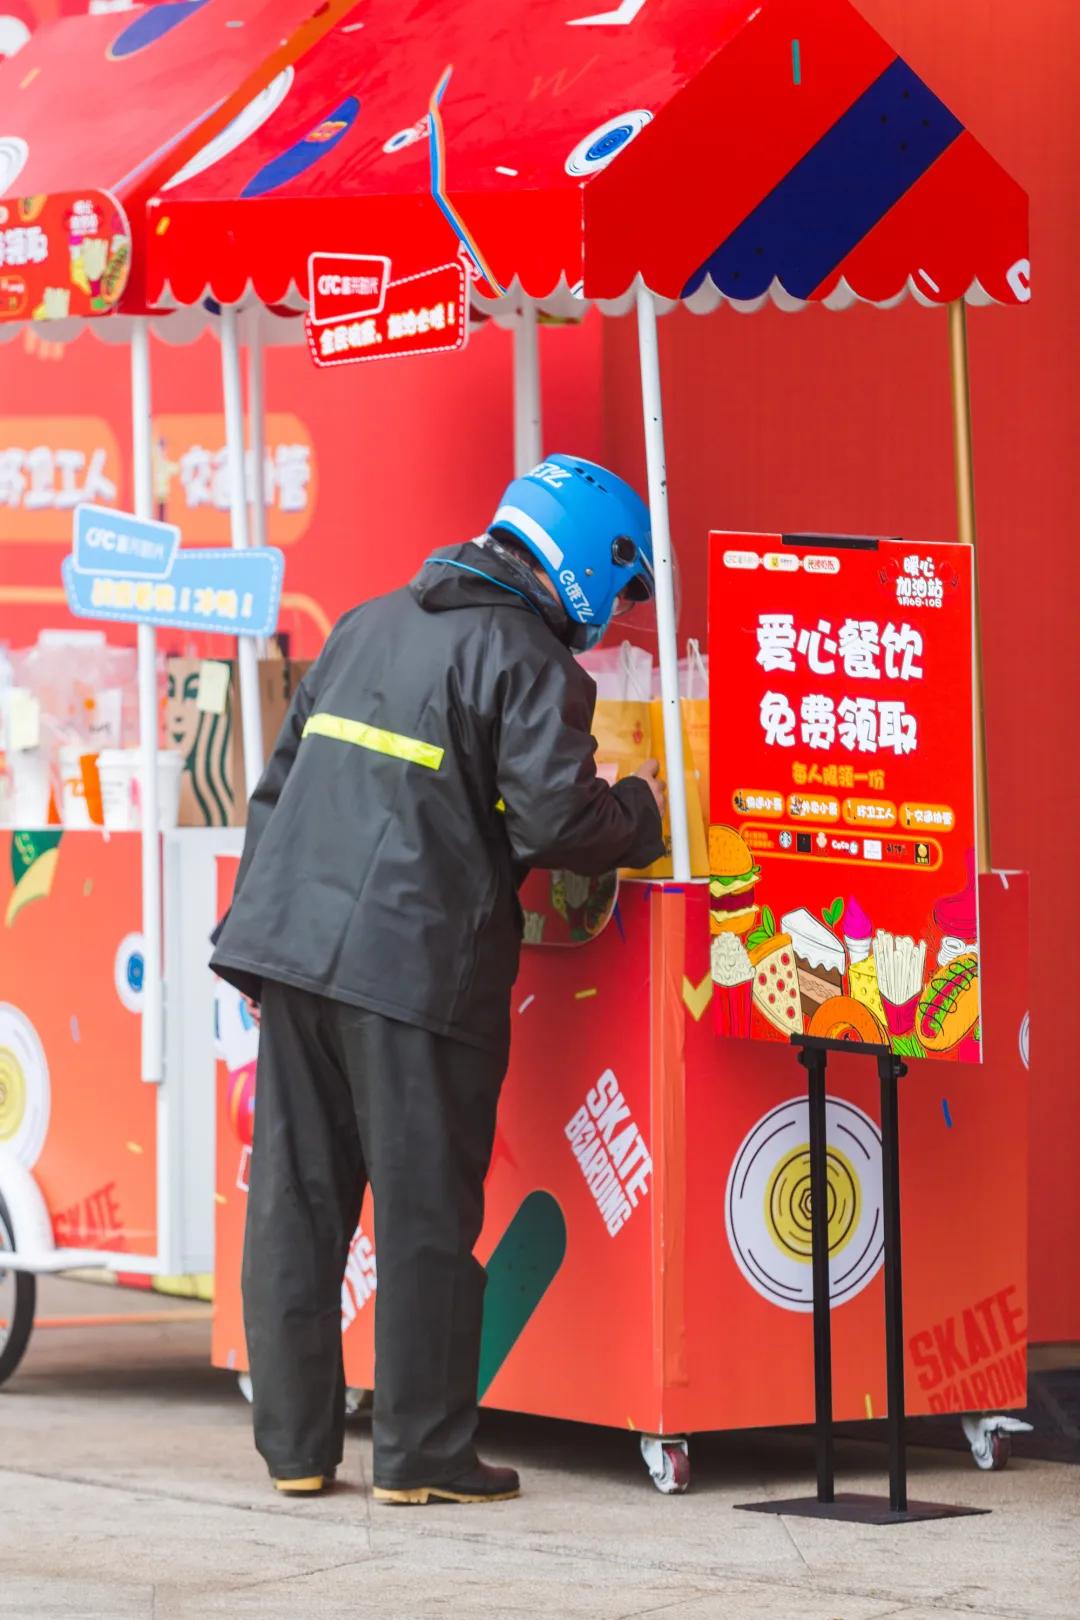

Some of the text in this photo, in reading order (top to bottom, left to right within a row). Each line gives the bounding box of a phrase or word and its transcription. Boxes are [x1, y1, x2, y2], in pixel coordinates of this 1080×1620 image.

[896, 576, 944, 599] 加油站
[756, 614, 923, 680] 爱心餐饮
[760, 690, 917, 755] 免费领取
[792, 761, 885, 790] 每人限领一份
[586, 1068, 653, 1208] SKATE
[909, 1284, 1027, 1391] SKATE
